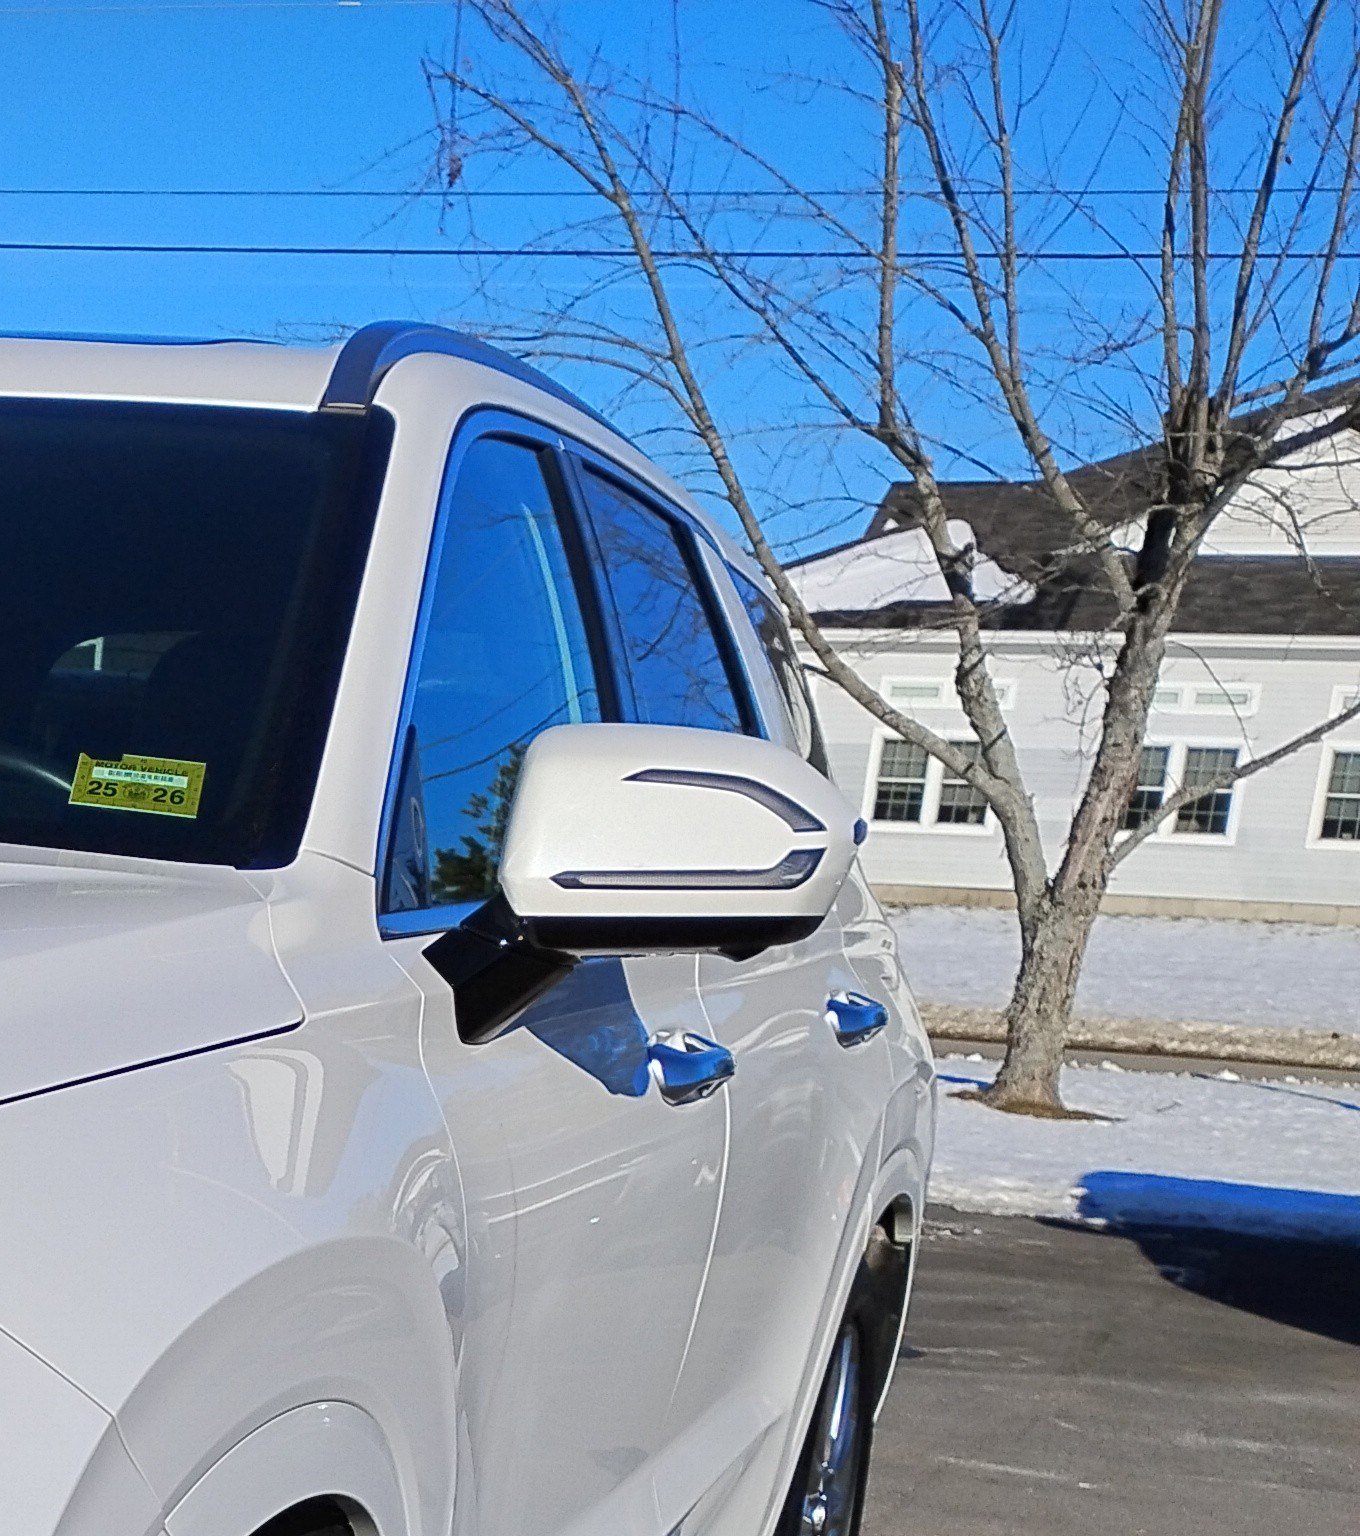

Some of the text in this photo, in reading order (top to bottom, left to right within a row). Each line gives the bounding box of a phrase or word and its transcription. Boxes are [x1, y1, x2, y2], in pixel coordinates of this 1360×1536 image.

[94, 760, 139, 772] MOTOR
[140, 764, 189, 776] VEHICLE
[86, 780, 186, 805] 25 26
